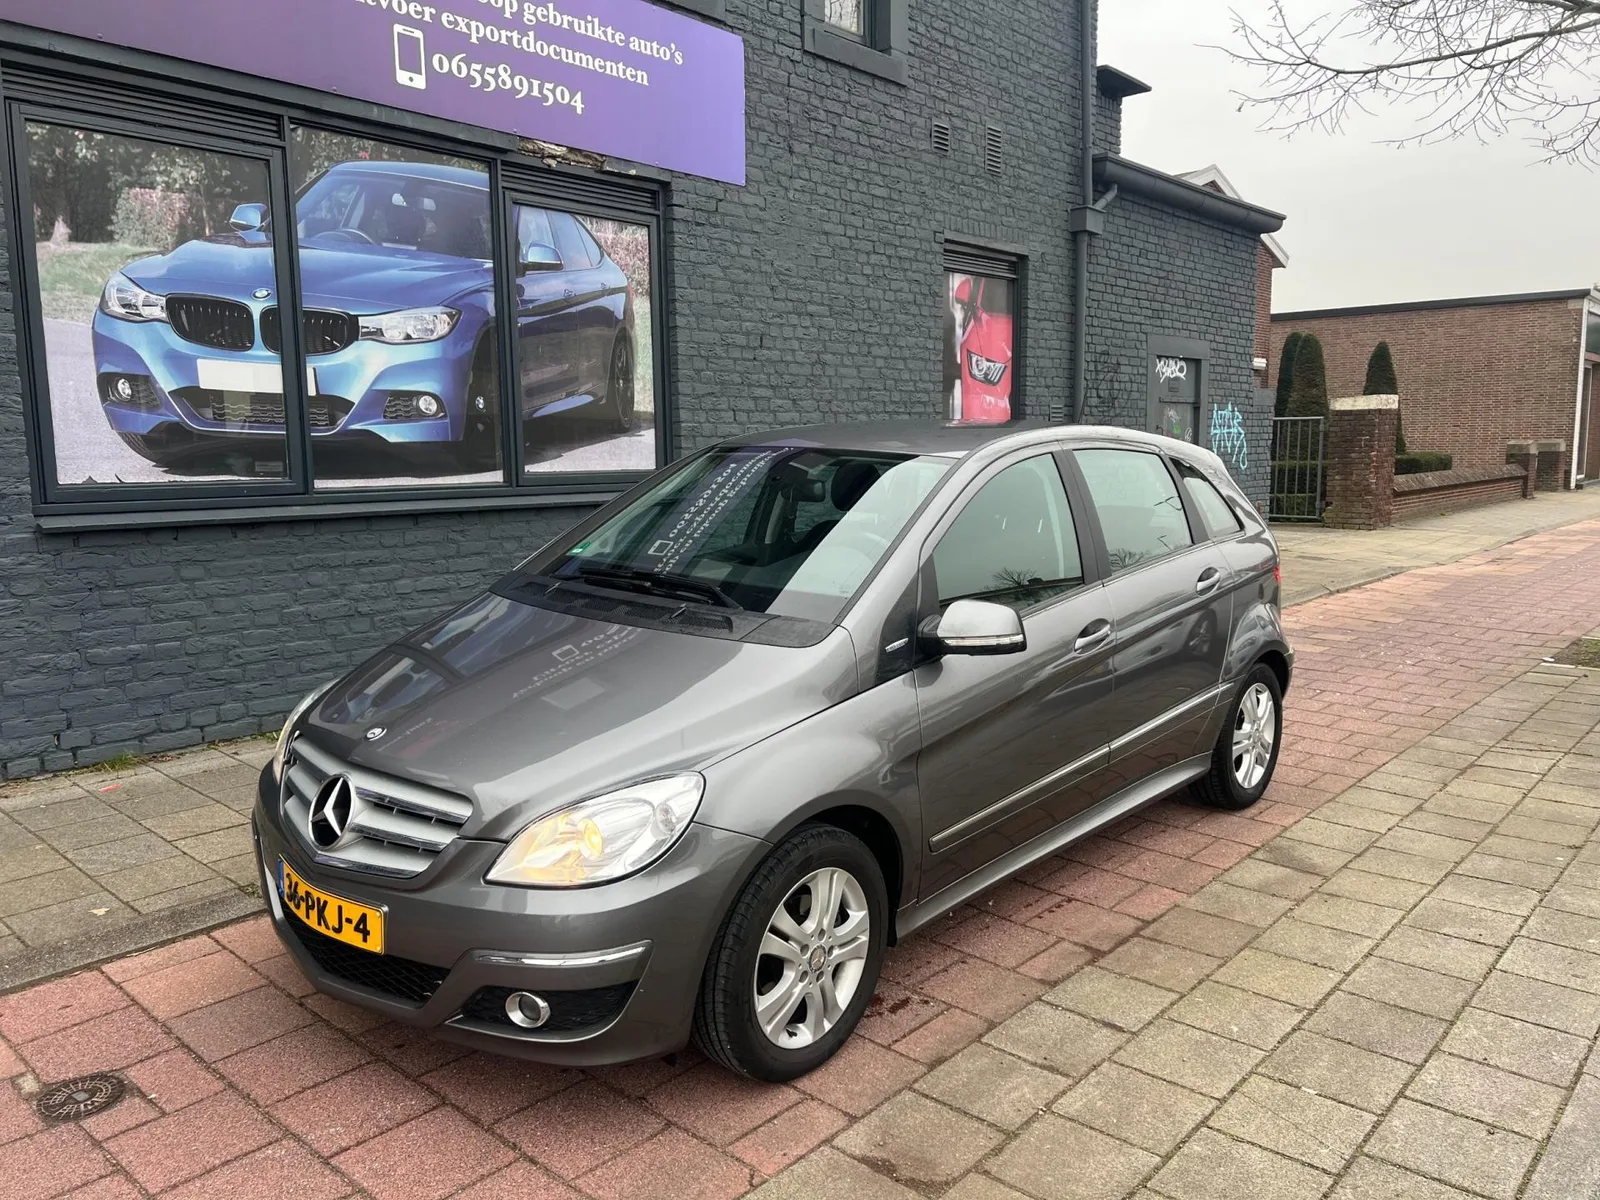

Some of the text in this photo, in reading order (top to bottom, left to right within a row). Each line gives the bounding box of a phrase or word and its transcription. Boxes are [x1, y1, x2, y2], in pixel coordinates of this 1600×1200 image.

[357, 0, 650, 87] voer exportdocumenten
[522, 2, 626, 47] gebruikte
[629, 36, 685, 66] auto’s
[432, 53, 586, 115] 0655891504
[285, 872, 371, 943] 36-PKJ-4
